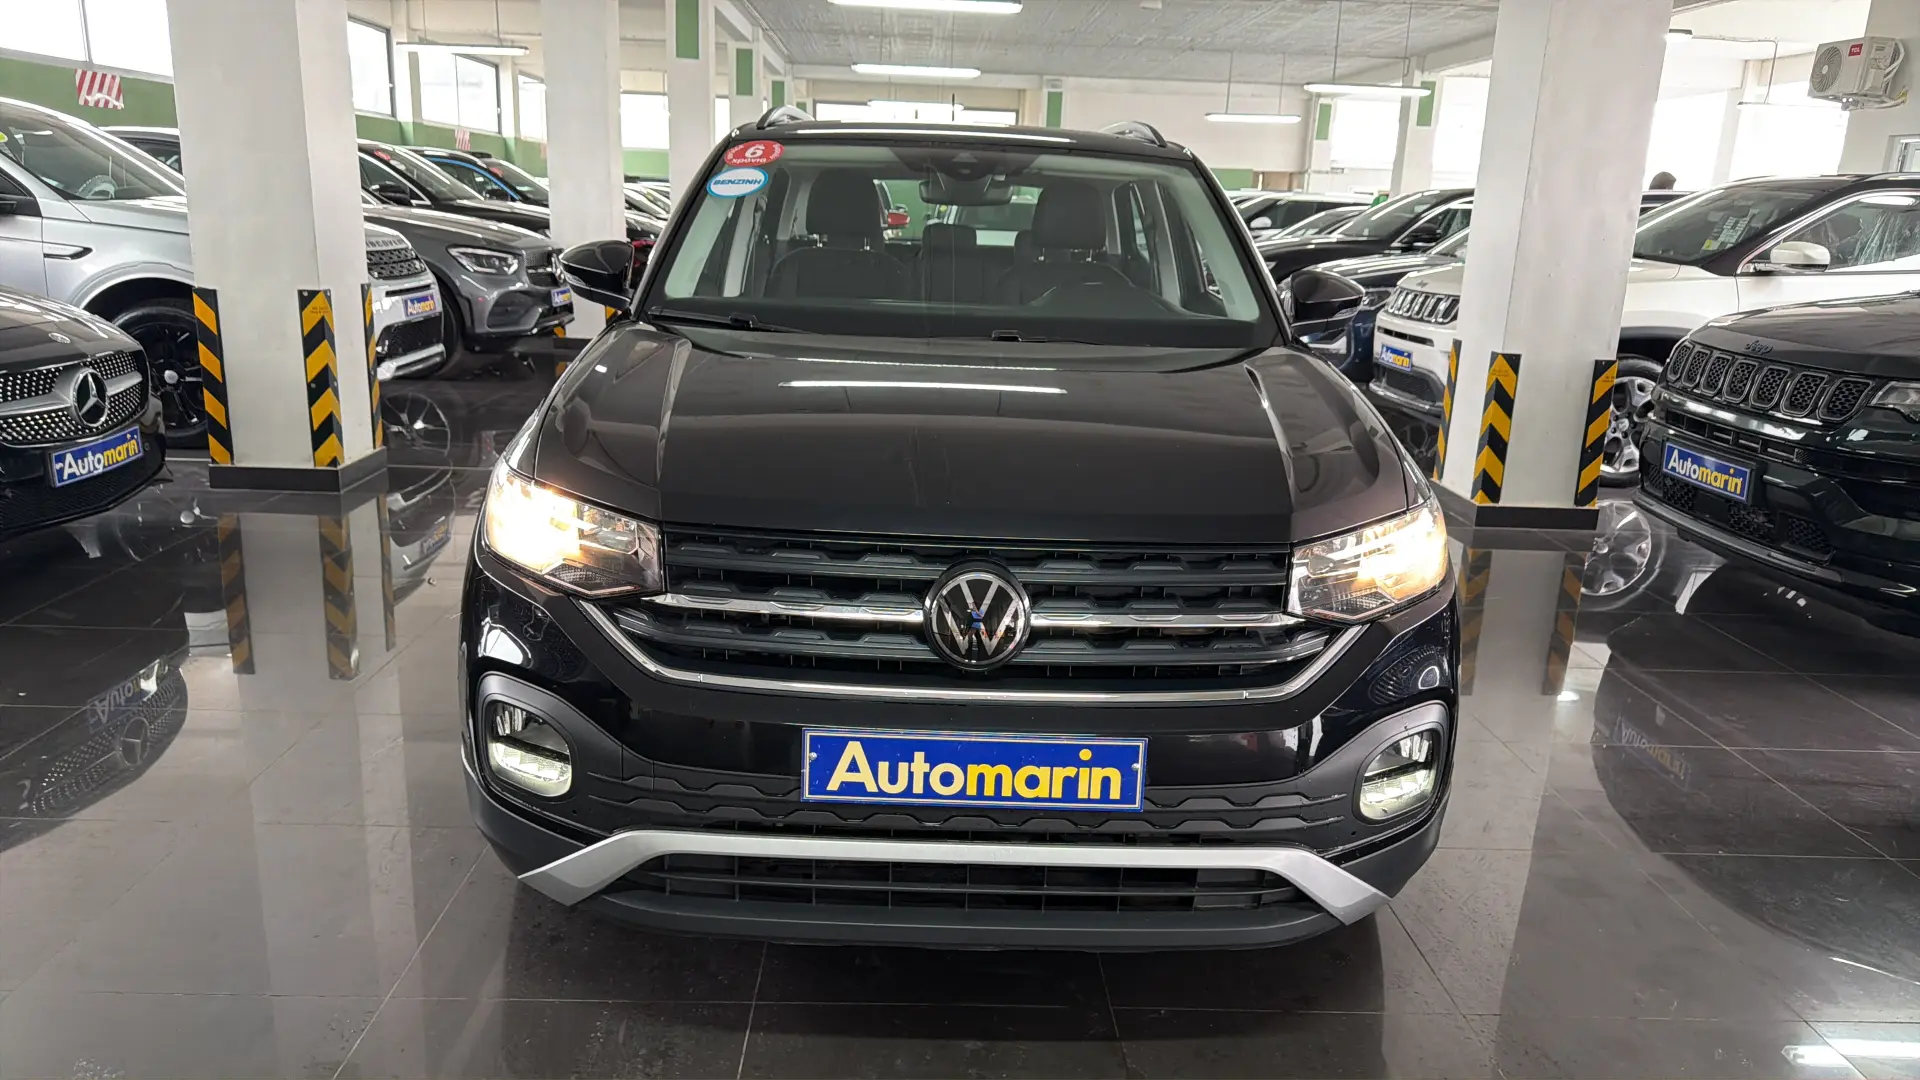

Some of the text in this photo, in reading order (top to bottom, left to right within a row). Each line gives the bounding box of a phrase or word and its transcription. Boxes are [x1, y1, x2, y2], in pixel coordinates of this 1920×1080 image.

[744, 143, 766, 158] 6
[1744, 340, 1774, 355] Jeep
[62, 433, 138, 480] Automarin
[1667, 448, 1743, 495] Automarin
[826, 740, 1122, 800] Automarin
